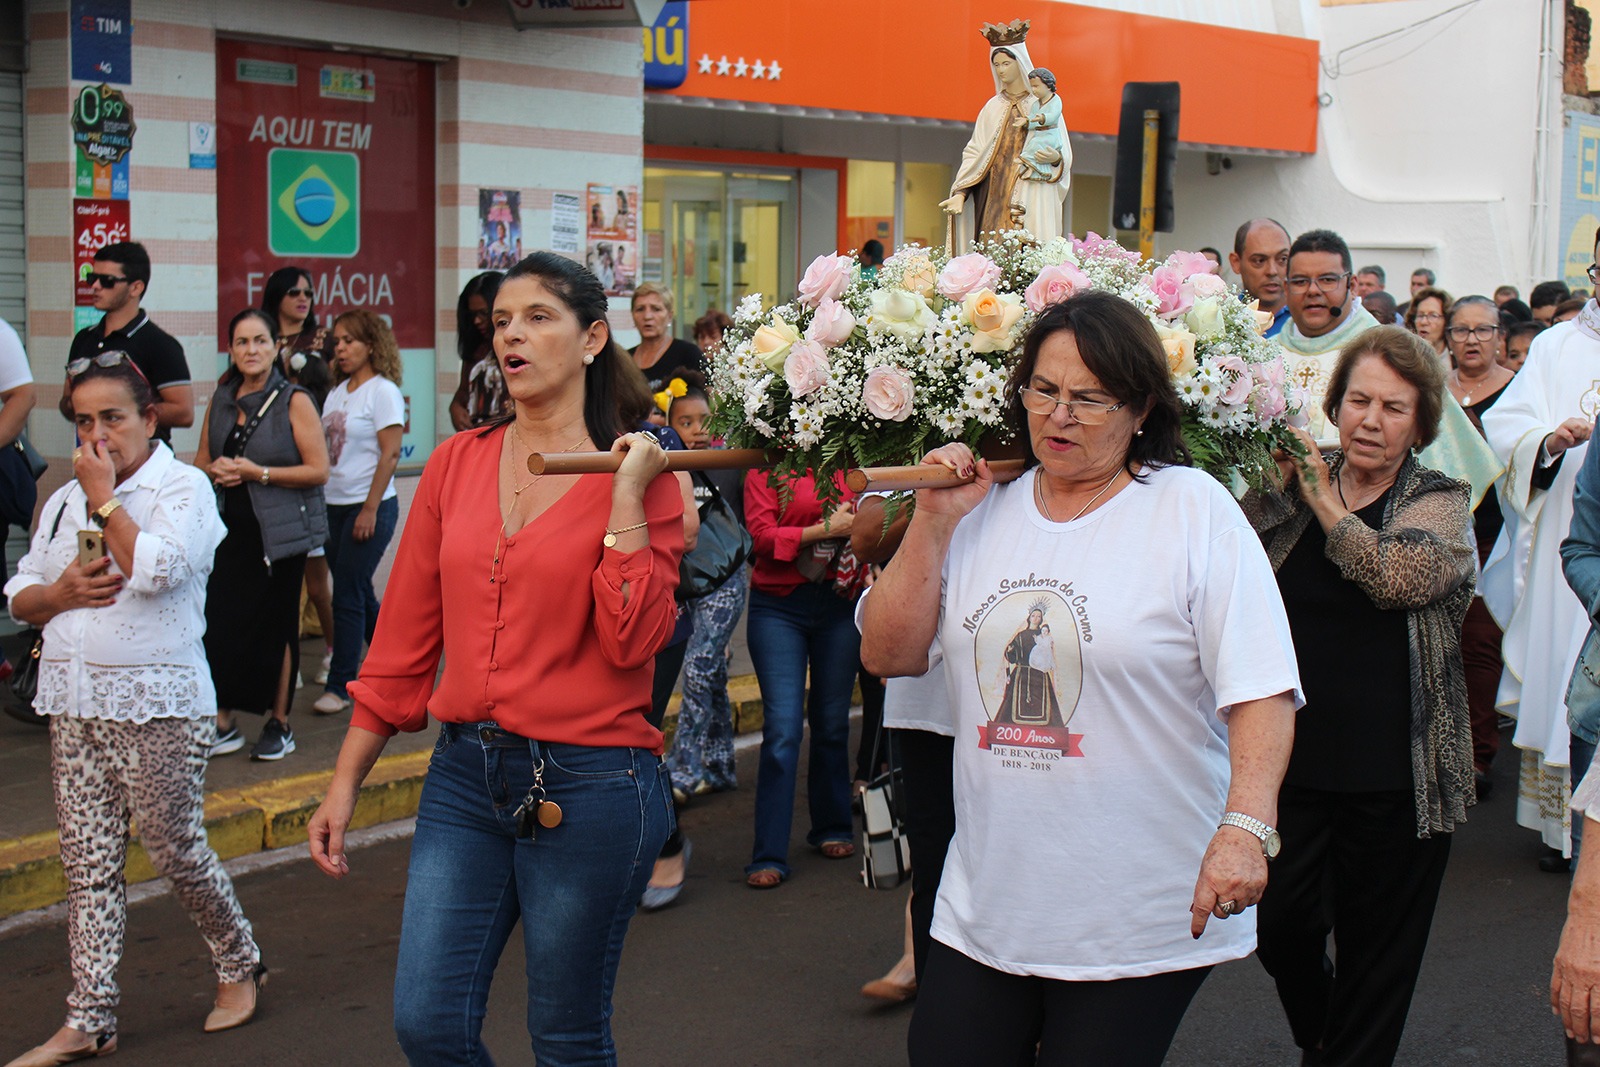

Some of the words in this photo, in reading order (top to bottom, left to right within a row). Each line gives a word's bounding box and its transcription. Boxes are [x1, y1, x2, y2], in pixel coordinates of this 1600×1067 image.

[96, 17, 122, 35] TIM
[248, 115, 315, 146] AQUI
[321, 120, 373, 150] TEM
[247, 265, 394, 307] FMÁCIA
[962, 594, 997, 635] Nossa
[998, 572, 1060, 594] Senhora
[1059, 581, 1075, 597] do
[1071, 595, 1093, 644] Carmo
[996, 727, 1022, 741] 200
[1024, 729, 1056, 744] Anos
[993, 747, 1007, 756] DE
[1010, 748, 1060, 760] BENÇÃOS
[1001, 760, 1022, 769] 1818
[1030, 761, 1051, 771] 2018
